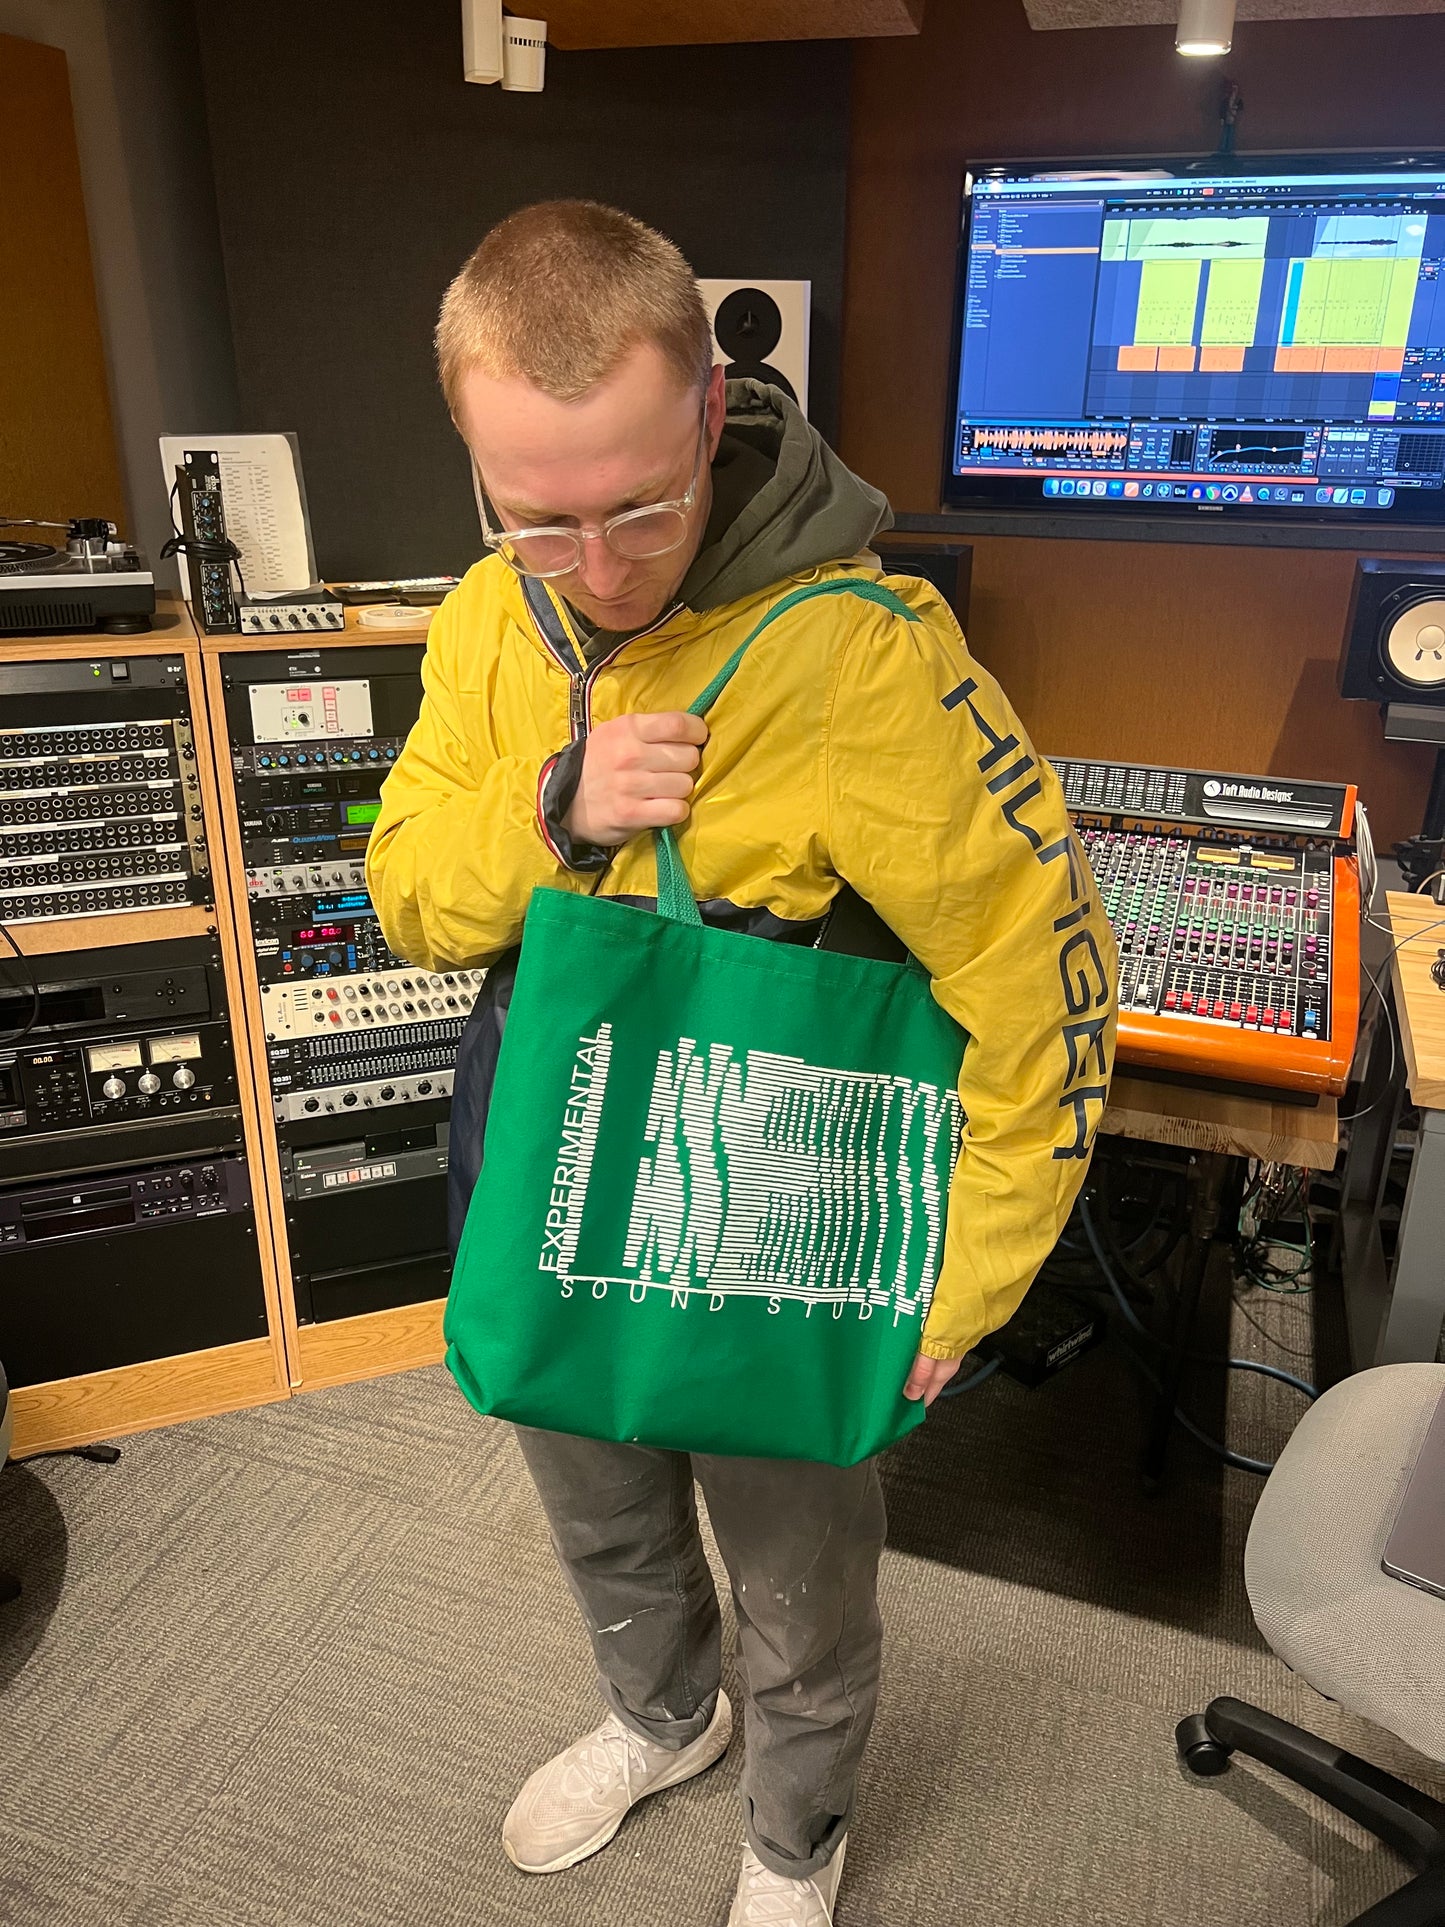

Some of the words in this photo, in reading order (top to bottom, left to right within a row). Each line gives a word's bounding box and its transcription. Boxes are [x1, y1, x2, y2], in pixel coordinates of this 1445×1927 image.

[1222, 783, 1239, 797] Toft
[1239, 785, 1261, 799] Audio
[1261, 787, 1293, 803] Designs
[248, 877, 265, 889] dbx
[941, 677, 1109, 1159] HILFIGER
[538, 1028, 604, 1272] EXPERIMENTAL
[560, 1278, 725, 1312] SOUND
[767, 1295, 926, 1333] STUDI
[1048, 1325, 1094, 1362] whirlwind
